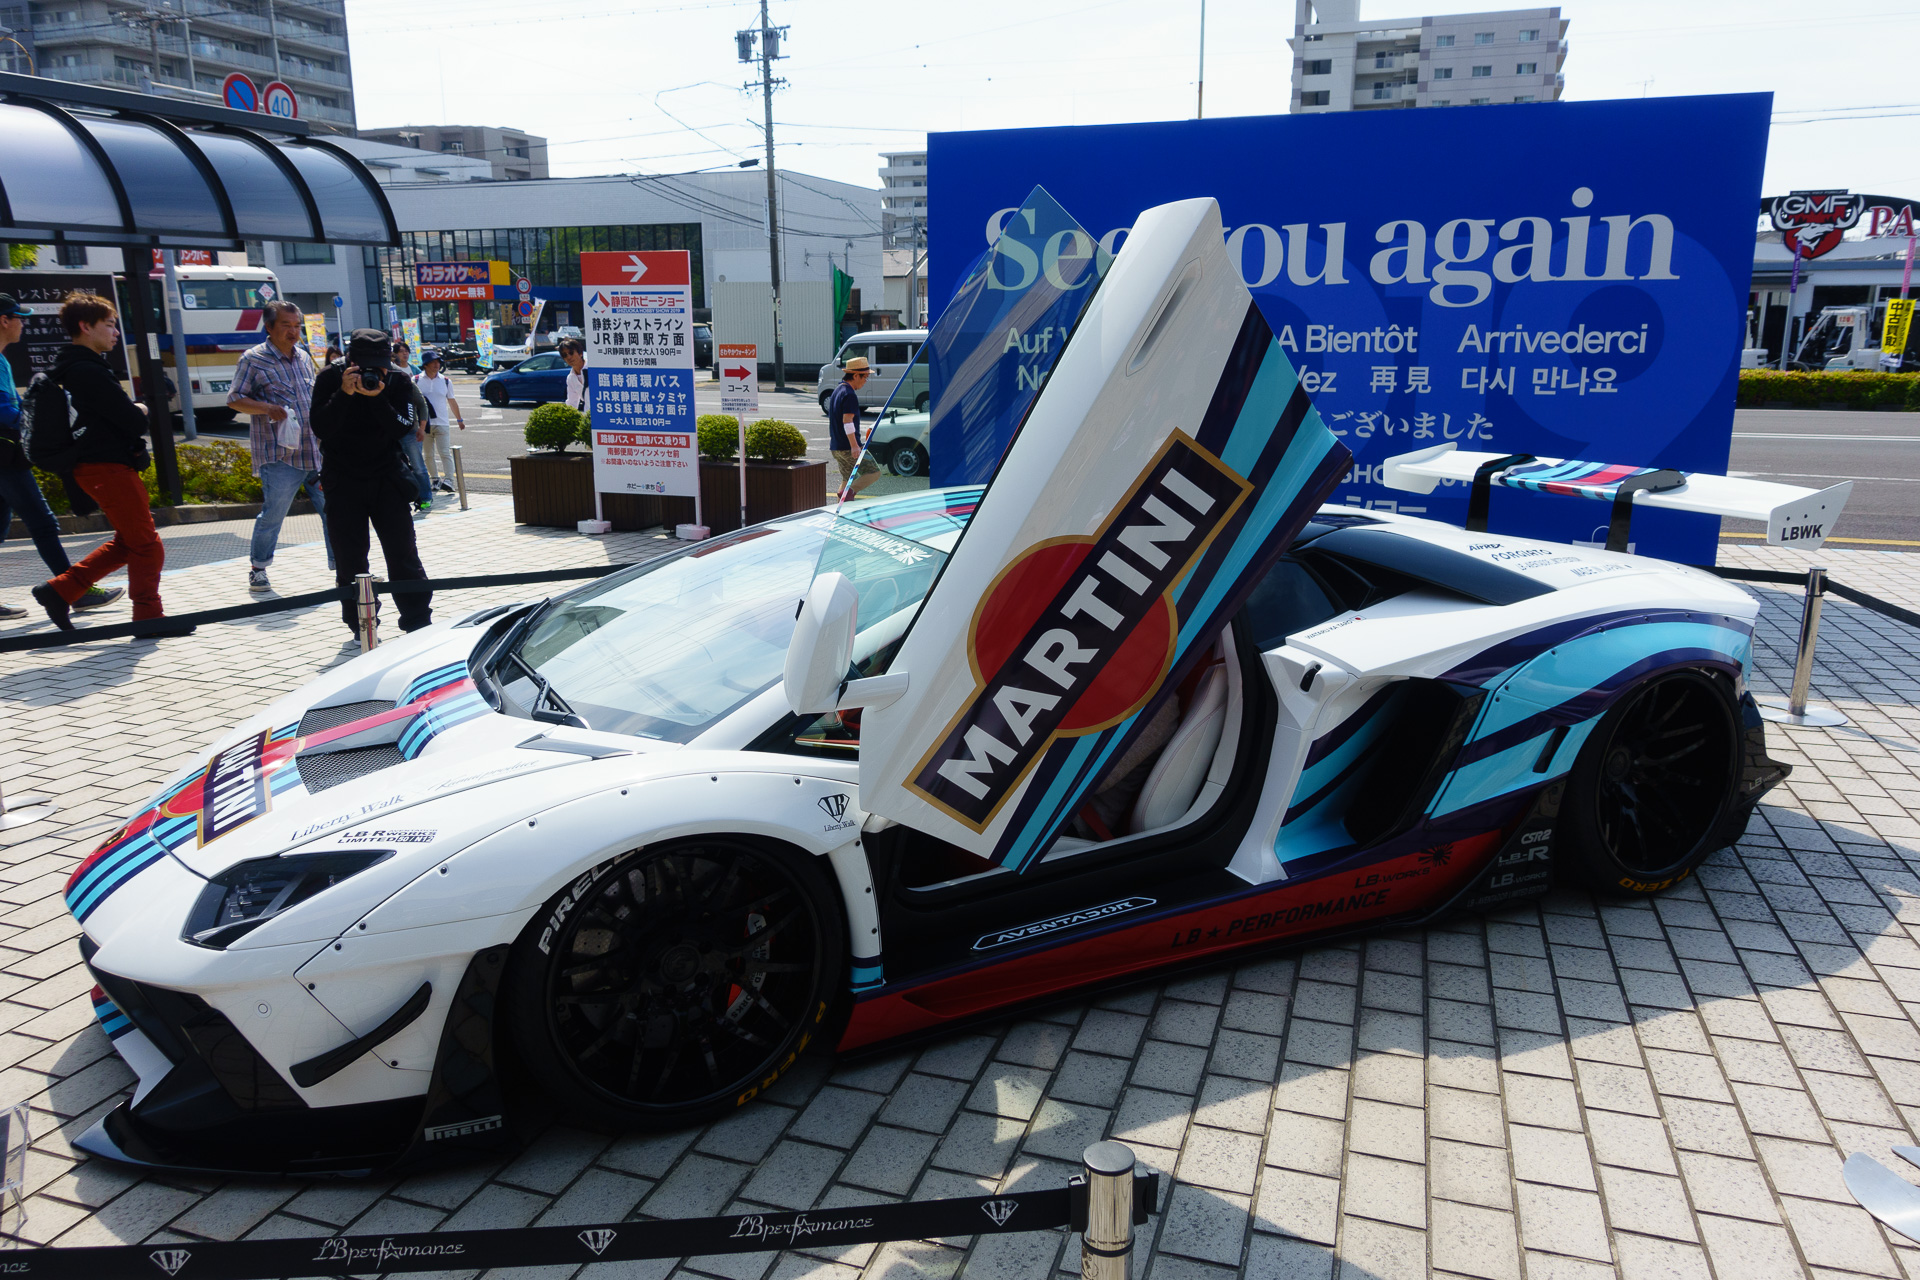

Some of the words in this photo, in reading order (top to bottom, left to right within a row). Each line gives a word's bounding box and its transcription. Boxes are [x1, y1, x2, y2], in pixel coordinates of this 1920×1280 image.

[271, 95, 290, 117] 40
[1782, 195, 1854, 214] GMF
[1223, 220, 1349, 288] ou
[1370, 186, 1680, 308] again
[420, 265, 469, 282] カラオケ
[422, 286, 486, 298] ドリンクバー無料
[519, 281, 528, 290] 30
[611, 296, 685, 307] 静岡ホビーショー
[592, 317, 683, 331] 静鉄ジャストライン
[593, 332, 684, 346] JR静岡駅方面
[1003, 326, 1054, 354] Auf
[1278, 325, 1299, 353] A
[1305, 324, 1418, 353] Bientôt
[1457, 324, 1648, 354] Arrivederci
[29, 355, 47, 364] TEL
[622, 358, 657, 366] 約15分間隔
[598, 373, 681, 388] 臨時循環バス
[728, 384, 750, 392] コース
[1370, 366, 1432, 394] 再見
[1461, 366, 1516, 395] 다시
[1532, 366, 1618, 396] 만나요
[596, 390, 687, 403] JR東静岡駅・タミヤ
[596, 403, 687, 416] SBS駐車場方面行
[1319, 410, 1494, 440] ございました
[600, 434, 687, 446] 路線バス・臨時バス乗り場
[1780, 523, 1823, 542] LBWK
[936, 467, 1216, 800] MARTINI
[213, 735, 260, 831] MARTINI
[289, 811, 356, 842] Liberty
[350, 794, 405, 819] Walk
[1520, 828, 1553, 845] CSR2
[1498, 845, 1551, 864] LB-R
[538, 846, 645, 956] PIRELL
[997, 902, 1132, 942] AVENTADOR
[1171, 929, 1202, 949] LB
[1226, 889, 1392, 935] PERFORMANCE
[424, 1114, 503, 1142] PIRELLI
